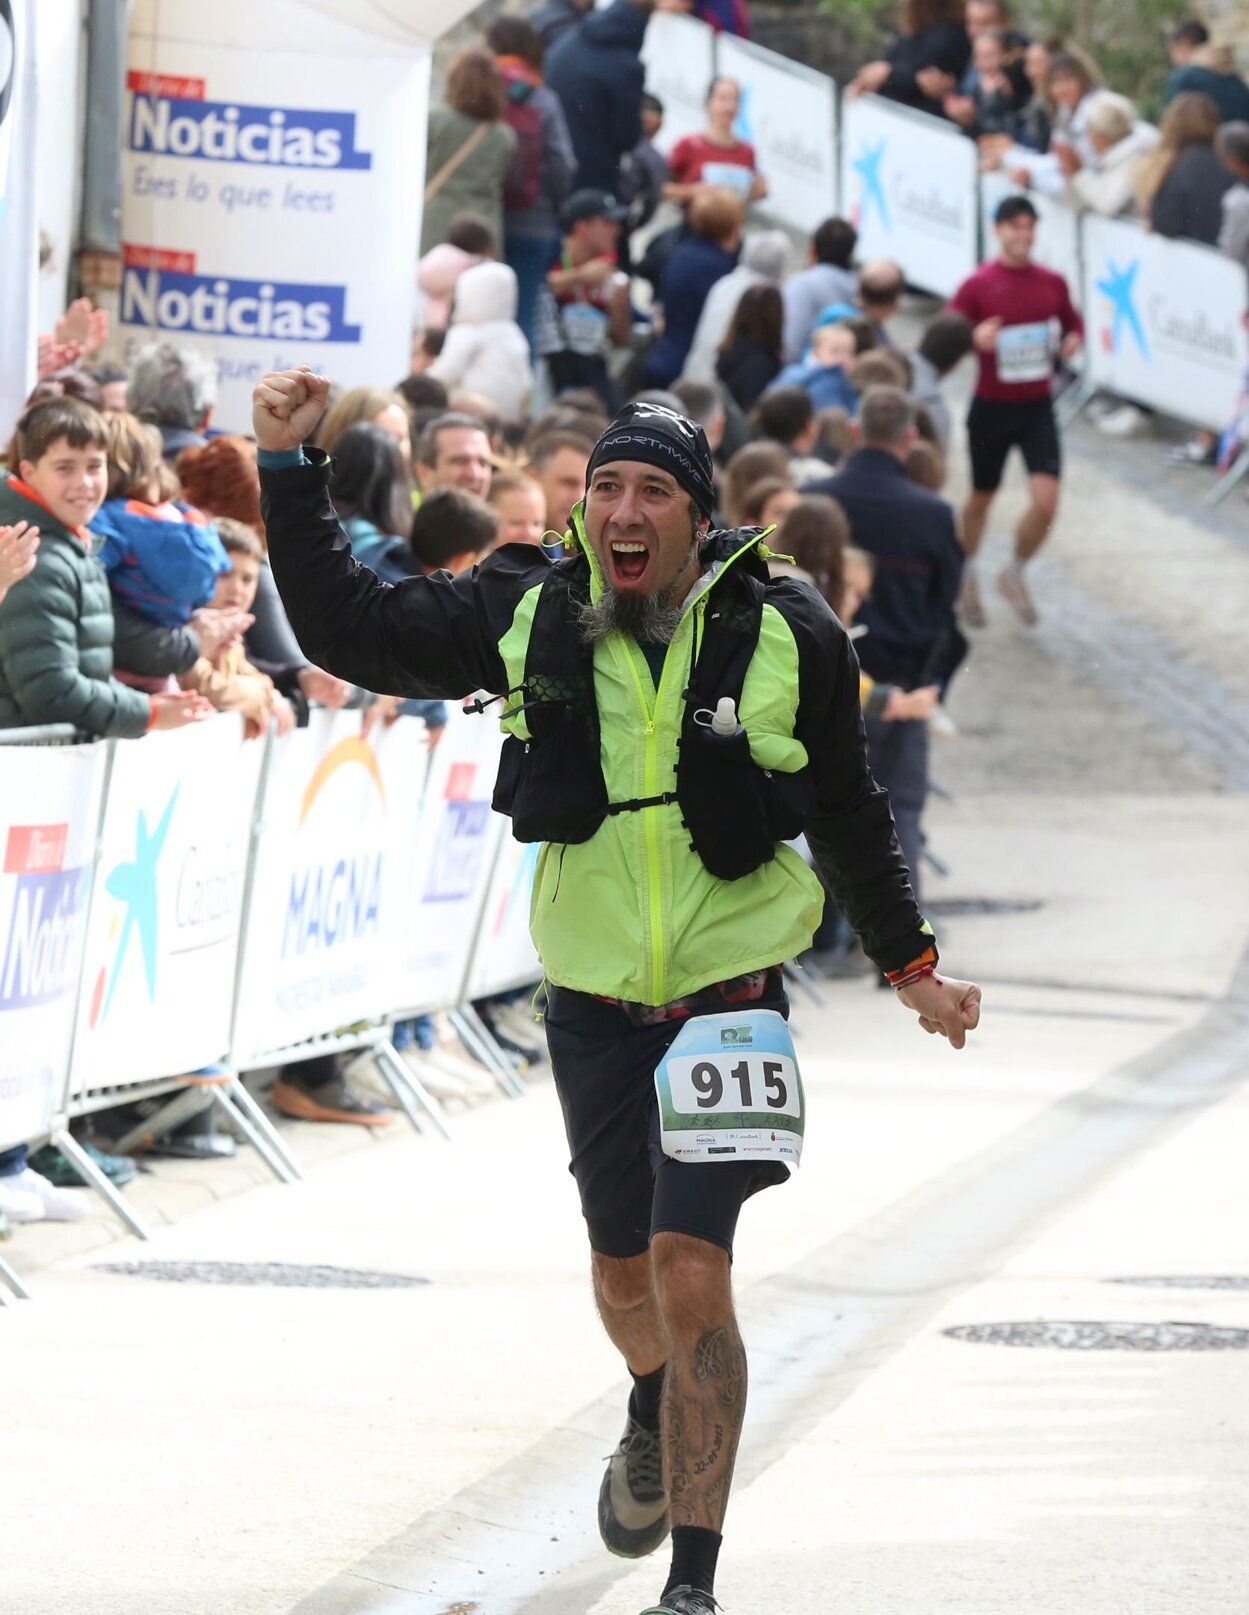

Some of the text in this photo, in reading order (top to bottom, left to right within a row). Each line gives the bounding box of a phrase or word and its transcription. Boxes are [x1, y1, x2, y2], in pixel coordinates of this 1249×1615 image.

[132, 96, 342, 167] Noticias
[186, 172, 210, 202] lo
[218, 181, 273, 213] que
[282, 179, 335, 212] lees
[122, 269, 332, 341] Noticias
[602, 435, 702, 482] NORTHWAVE
[280, 848, 382, 961] MAGNA
[690, 1060, 788, 1109] 915
